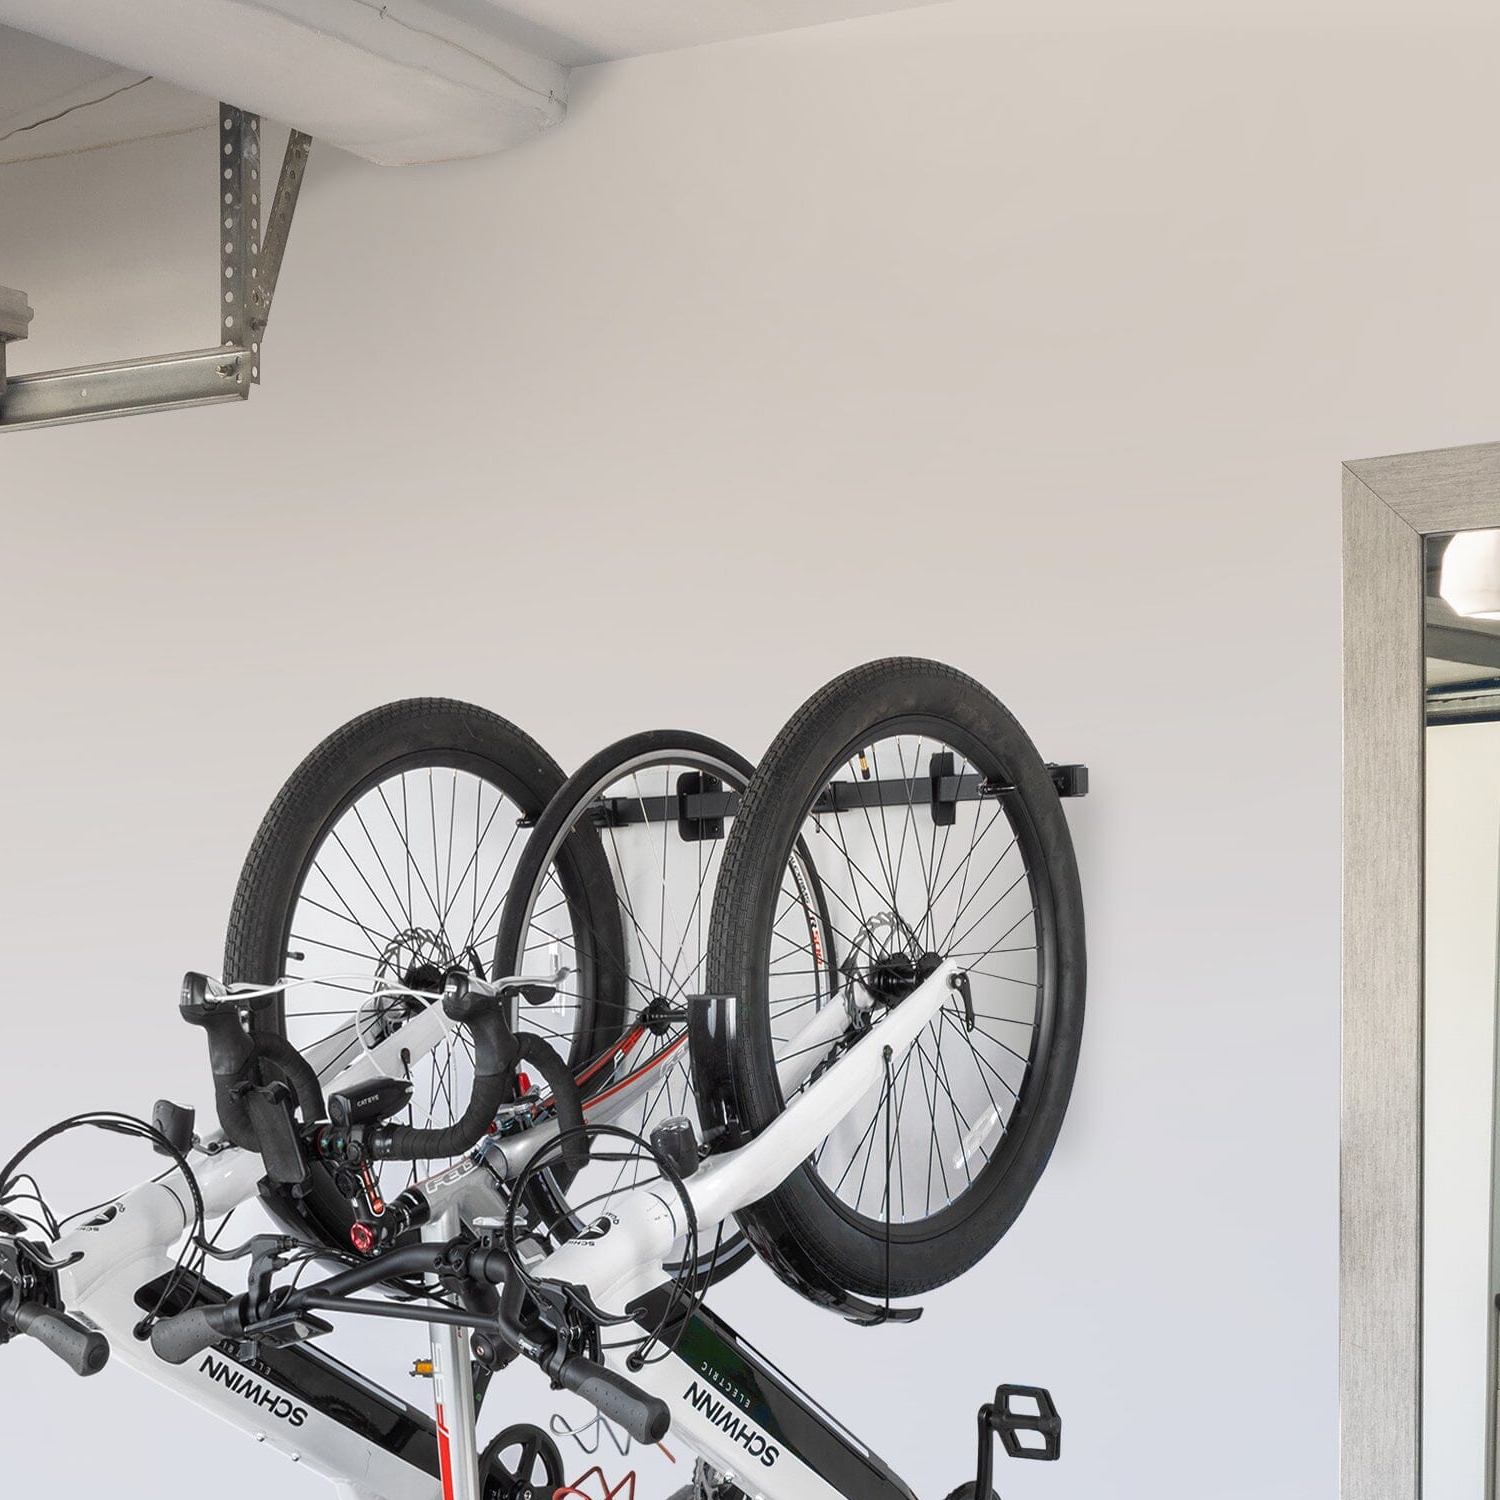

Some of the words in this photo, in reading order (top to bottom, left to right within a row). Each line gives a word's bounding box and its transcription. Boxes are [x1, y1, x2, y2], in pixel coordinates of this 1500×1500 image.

[356, 1094, 379, 1107] CATEYE
[199, 1355, 308, 1427] SCHWINN
[701, 1361, 751, 1408] ELECTRIC
[682, 1381, 780, 1467] SCHWINN
